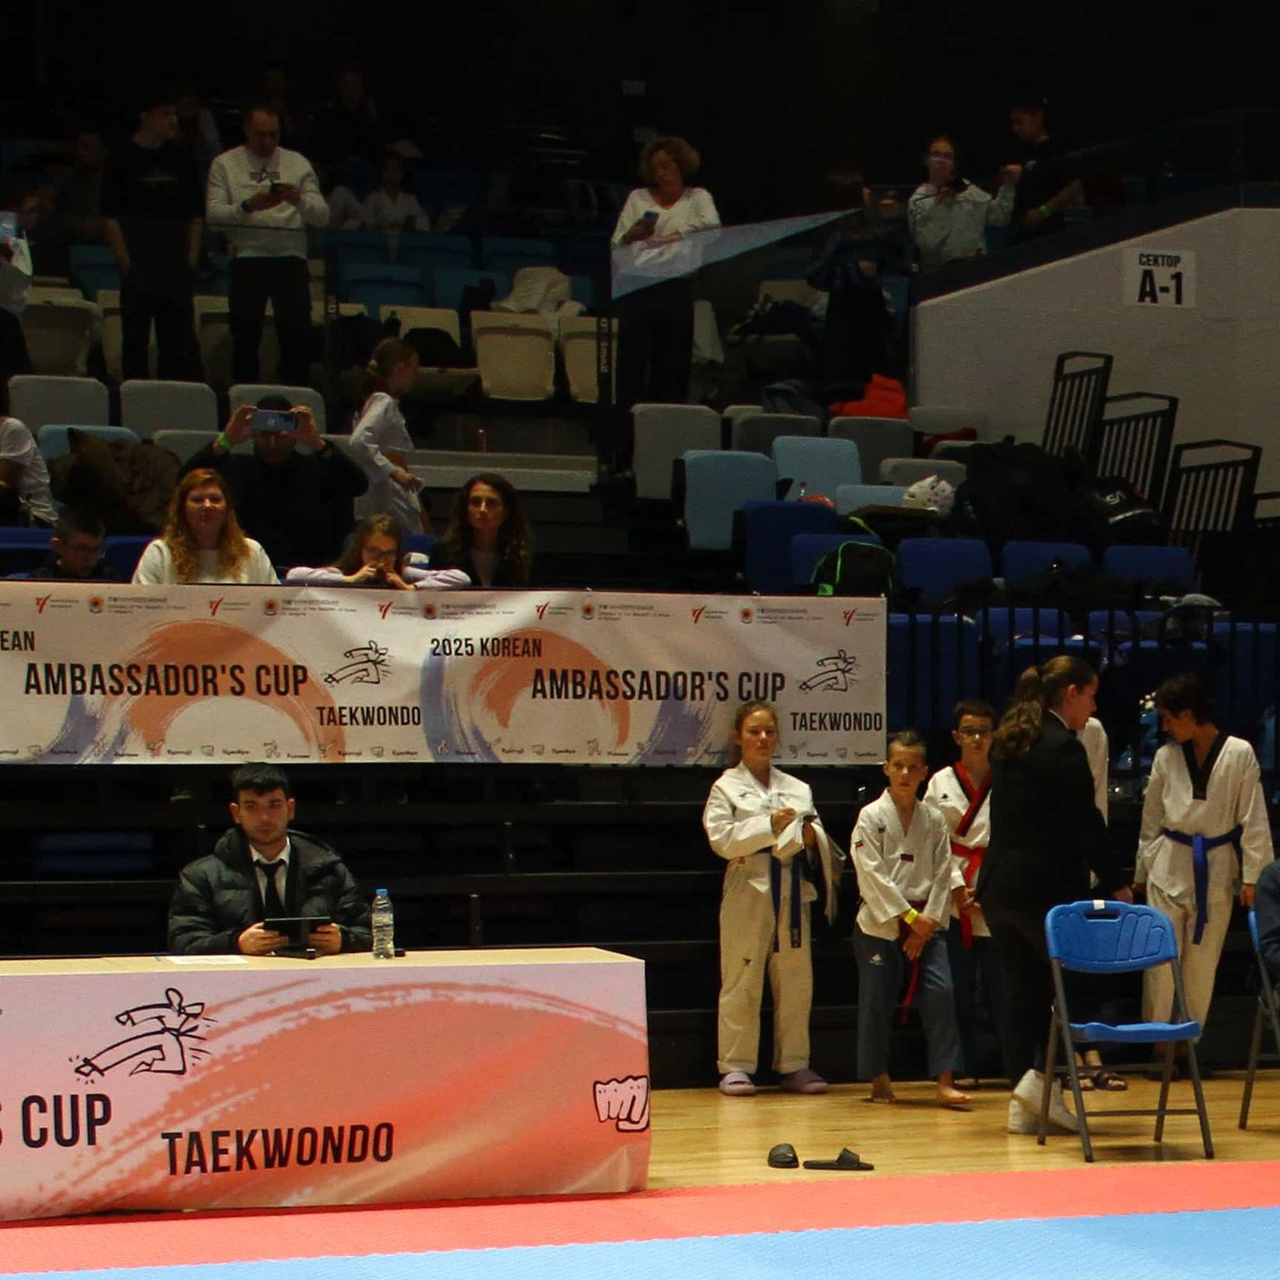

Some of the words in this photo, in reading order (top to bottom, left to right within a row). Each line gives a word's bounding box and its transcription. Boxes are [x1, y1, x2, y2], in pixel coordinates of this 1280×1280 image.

[1139, 253, 1181, 268] СЕКТОР
[1138, 269, 1183, 305] А-1
[430, 638, 475, 657] 2025
[480, 638, 542, 658] KOREAN
[24, 663, 246, 697] AMBASSADOR'S
[255, 664, 308, 697] CUP
[532, 668, 729, 702] AMBASSADOR'S
[738, 672, 786, 702] CUP
[316, 705, 422, 727] TAEKWONDO
[790, 712, 883, 732] TAEKWONDO
[21, 1093, 112, 1149] CUP
[161, 1122, 394, 1176] TAEKWONDO
